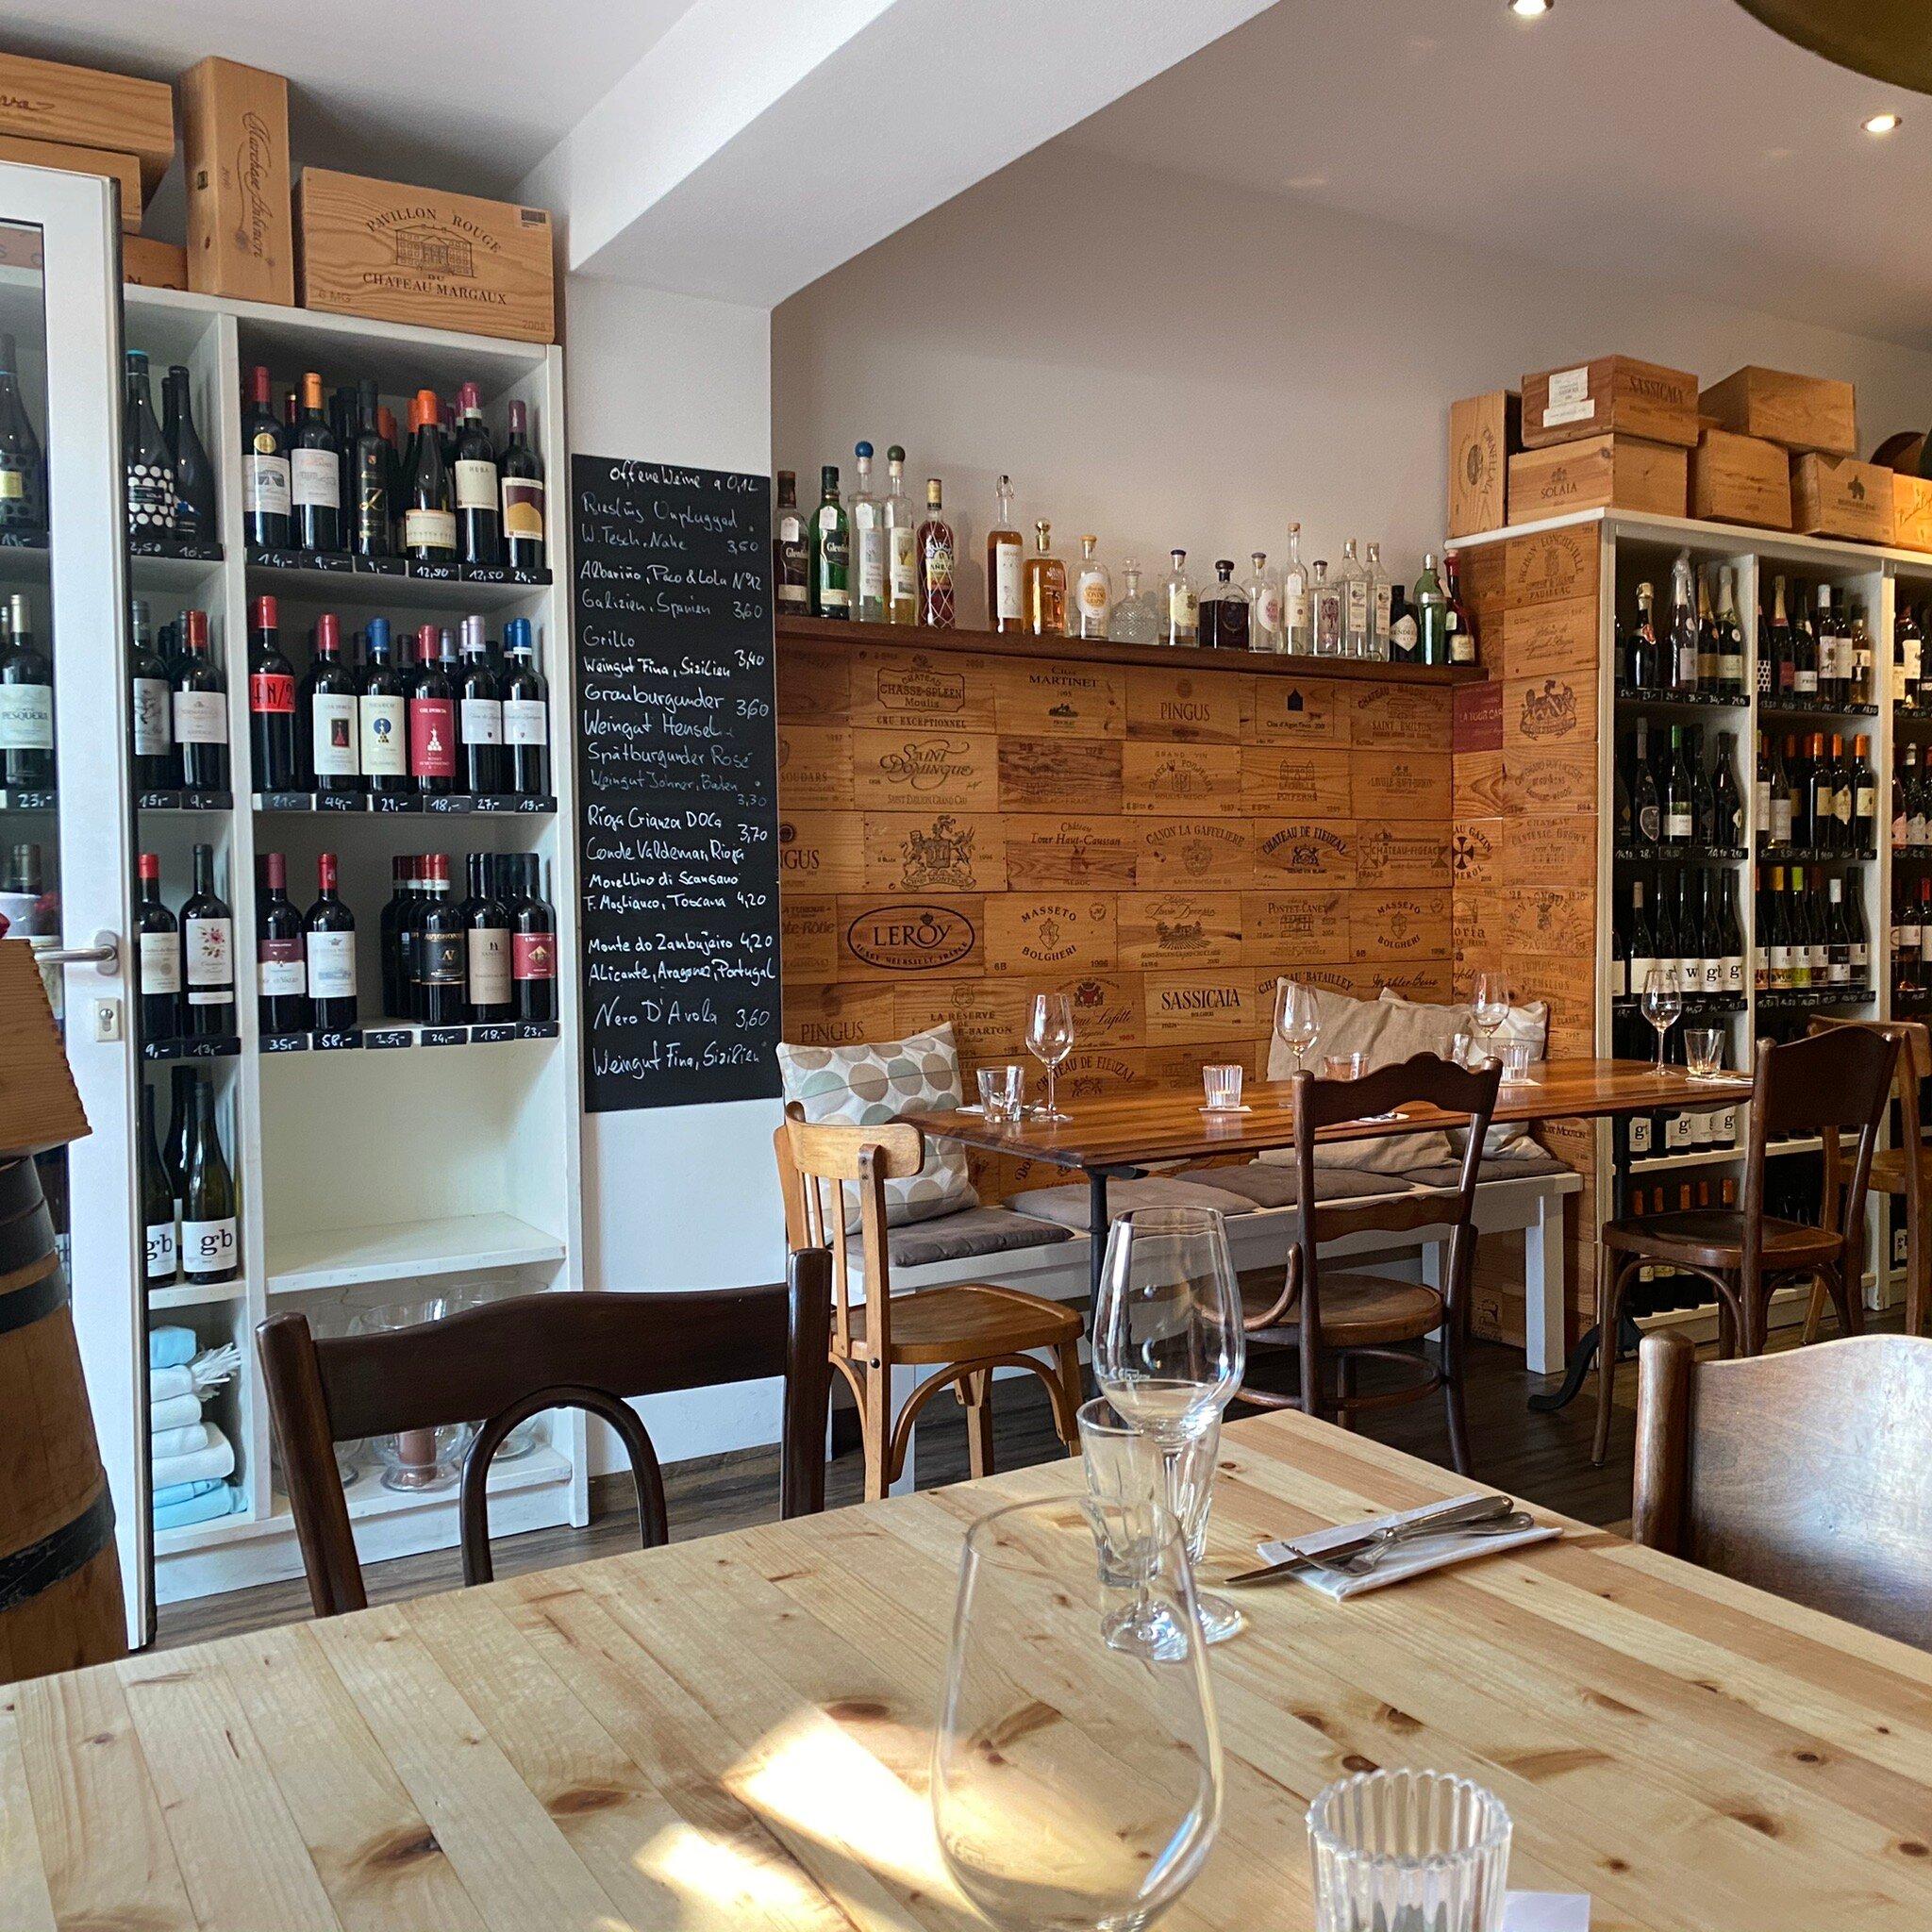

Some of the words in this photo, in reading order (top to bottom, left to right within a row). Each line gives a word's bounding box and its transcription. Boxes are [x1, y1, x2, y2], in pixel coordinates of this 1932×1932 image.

[365, 207, 437, 232] PAVILLON
[453, 214, 502, 253] ROUGE
[362, 272, 432, 292] CHATEAU
[436, 284, 507, 305] MARGAUX
[1483, 425, 1498, 495] ORNELLAIA
[1541, 483, 1578, 499] SOLAIA
[581, 491, 644, 523] Riesling
[653, 501, 739, 532] Unplugged
[650, 531, 689, 551] Nahe
[657, 591, 711, 619] Spanien
[583, 625, 636, 648] Grillo
[583, 656, 635, 678] Weingut
[679, 656, 731, 677] Sizilien
[734, 649, 765, 670] 3,40
[879, 684, 962, 700] CHASSE-SPLEEN
[1029, 675, 1098, 688] MARTINET
[584, 682, 724, 714] Grauburgunder
[736, 699, 769, 720] 3,60
[1160, 702, 1210, 721] PINGUS
[583, 708, 652, 741] Weingut
[876, 715, 894, 725] CRU
[900, 716, 967, 729] EXCEPTIONNEL
[588, 741, 705, 769] Spätburgunder
[710, 744, 754, 769] Rosé
[591, 769, 645, 791] Weingut
[628, 807, 682, 832] Crianza
[738, 824, 768, 843] 3,70
[1146, 828, 1176, 845] CANON
[1179, 825, 1191, 836] LA
[586, 837, 636, 861] Conde
[709, 839, 744, 864] Rioja
[1262, 827, 1297, 856] CHATEAU
[1300, 825, 1311, 838] DE
[1469, 826, 1492, 852] GAZIN
[589, 872, 655, 889] Morellino
[658, 873, 673, 887] di
[678, 871, 739, 887] Scansano
[667, 893, 726, 909] Toscana
[737, 891, 766, 908] 4,20
[1377, 901, 1421, 915] MASSETO
[1021, 906, 1076, 924] MASSETO
[588, 939, 630, 955] Monte
[635, 937, 653, 951] do
[656, 931, 733, 956] Zambujeiro
[740, 932, 773, 954] 4,20
[874, 924, 953, 949] LEROY
[1377, 934, 1421, 949] BOLGHERI
[1022, 945, 1077, 961] BOLGHERI
[711, 958, 776, 986] Portugal
[1306, 971, 1354, 991] BATAILLEY
[1161, 989, 1241, 1010] SASSICAIA
[593, 996, 638, 1030] Nero
[735, 1008, 770, 1031] 3,60
[929, 1012, 943, 1022] LA
[802, 1021, 864, 1041] PINGUS
[592, 1040, 662, 1079] Weingut
[702, 1041, 760, 1067] Sizilien
[200, 1228, 233, 1257] gb
